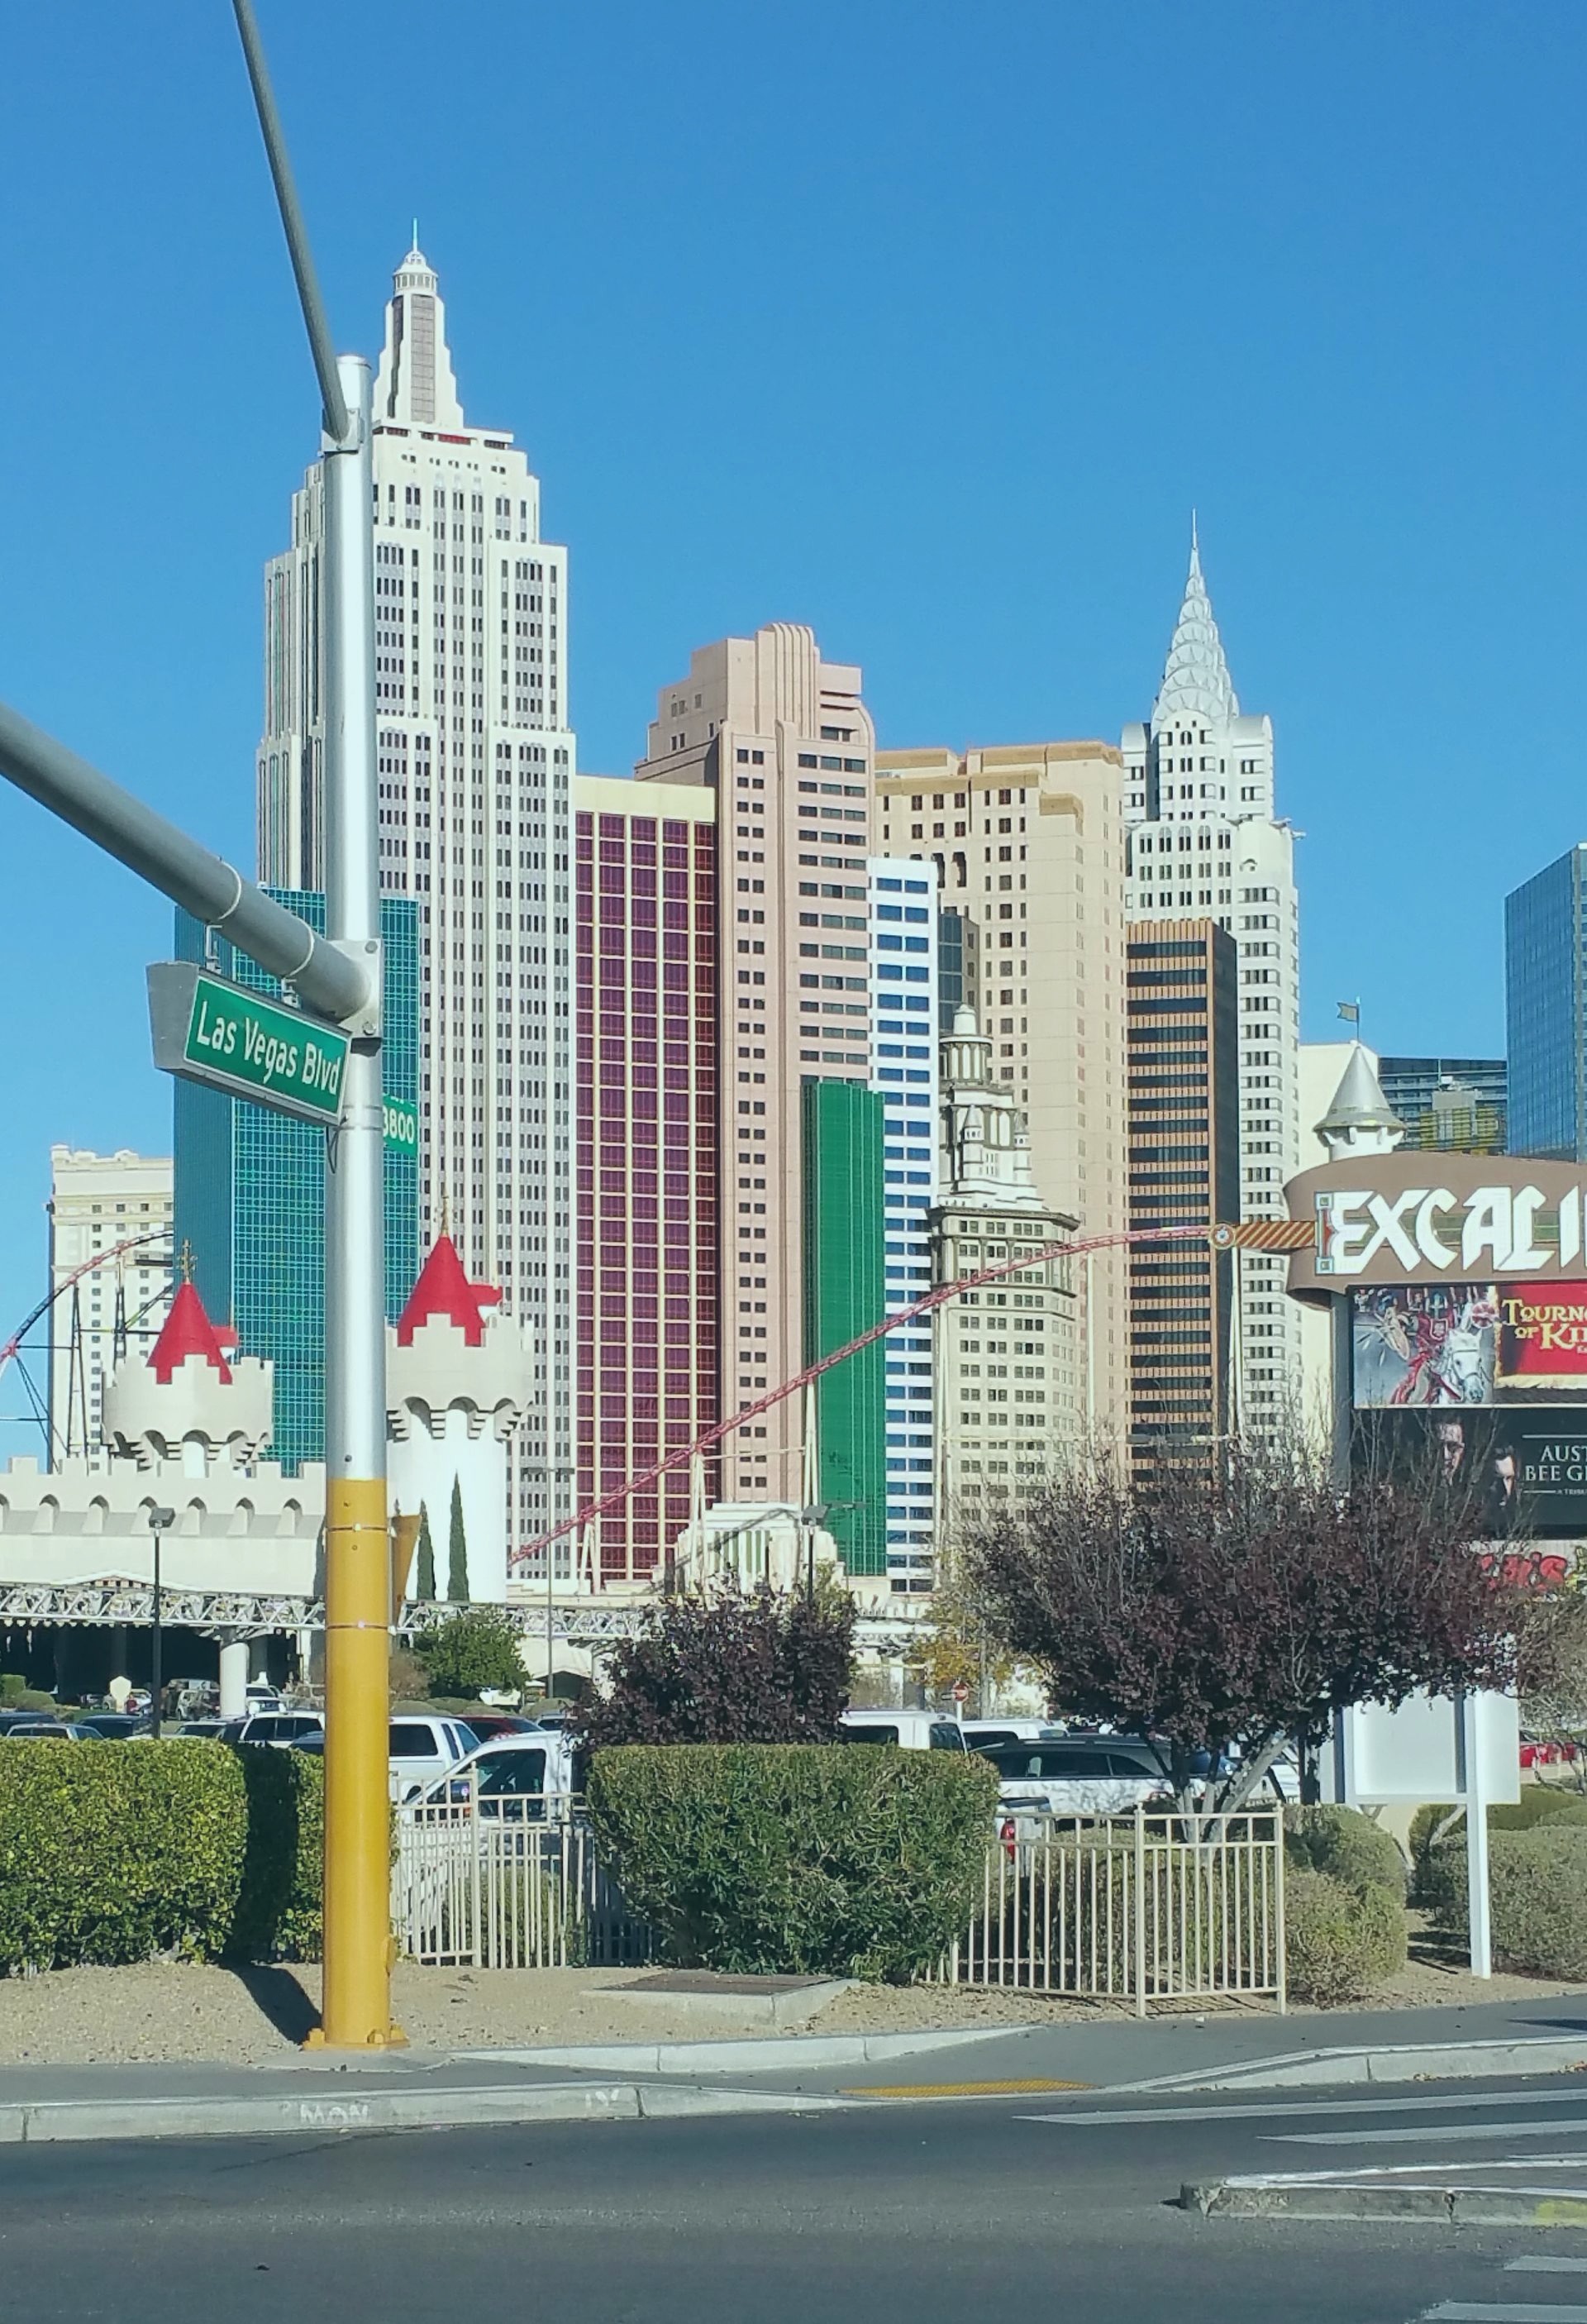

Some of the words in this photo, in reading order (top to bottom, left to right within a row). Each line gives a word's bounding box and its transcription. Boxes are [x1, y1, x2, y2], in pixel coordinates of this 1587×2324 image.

[197, 1001, 237, 1054] Las
[244, 1017, 298, 1084] Vegas
[302, 1042, 341, 1095] Blvd
[1331, 1185, 1587, 1274] EXCALI
[1525, 1465, 1561, 1481] BEE
